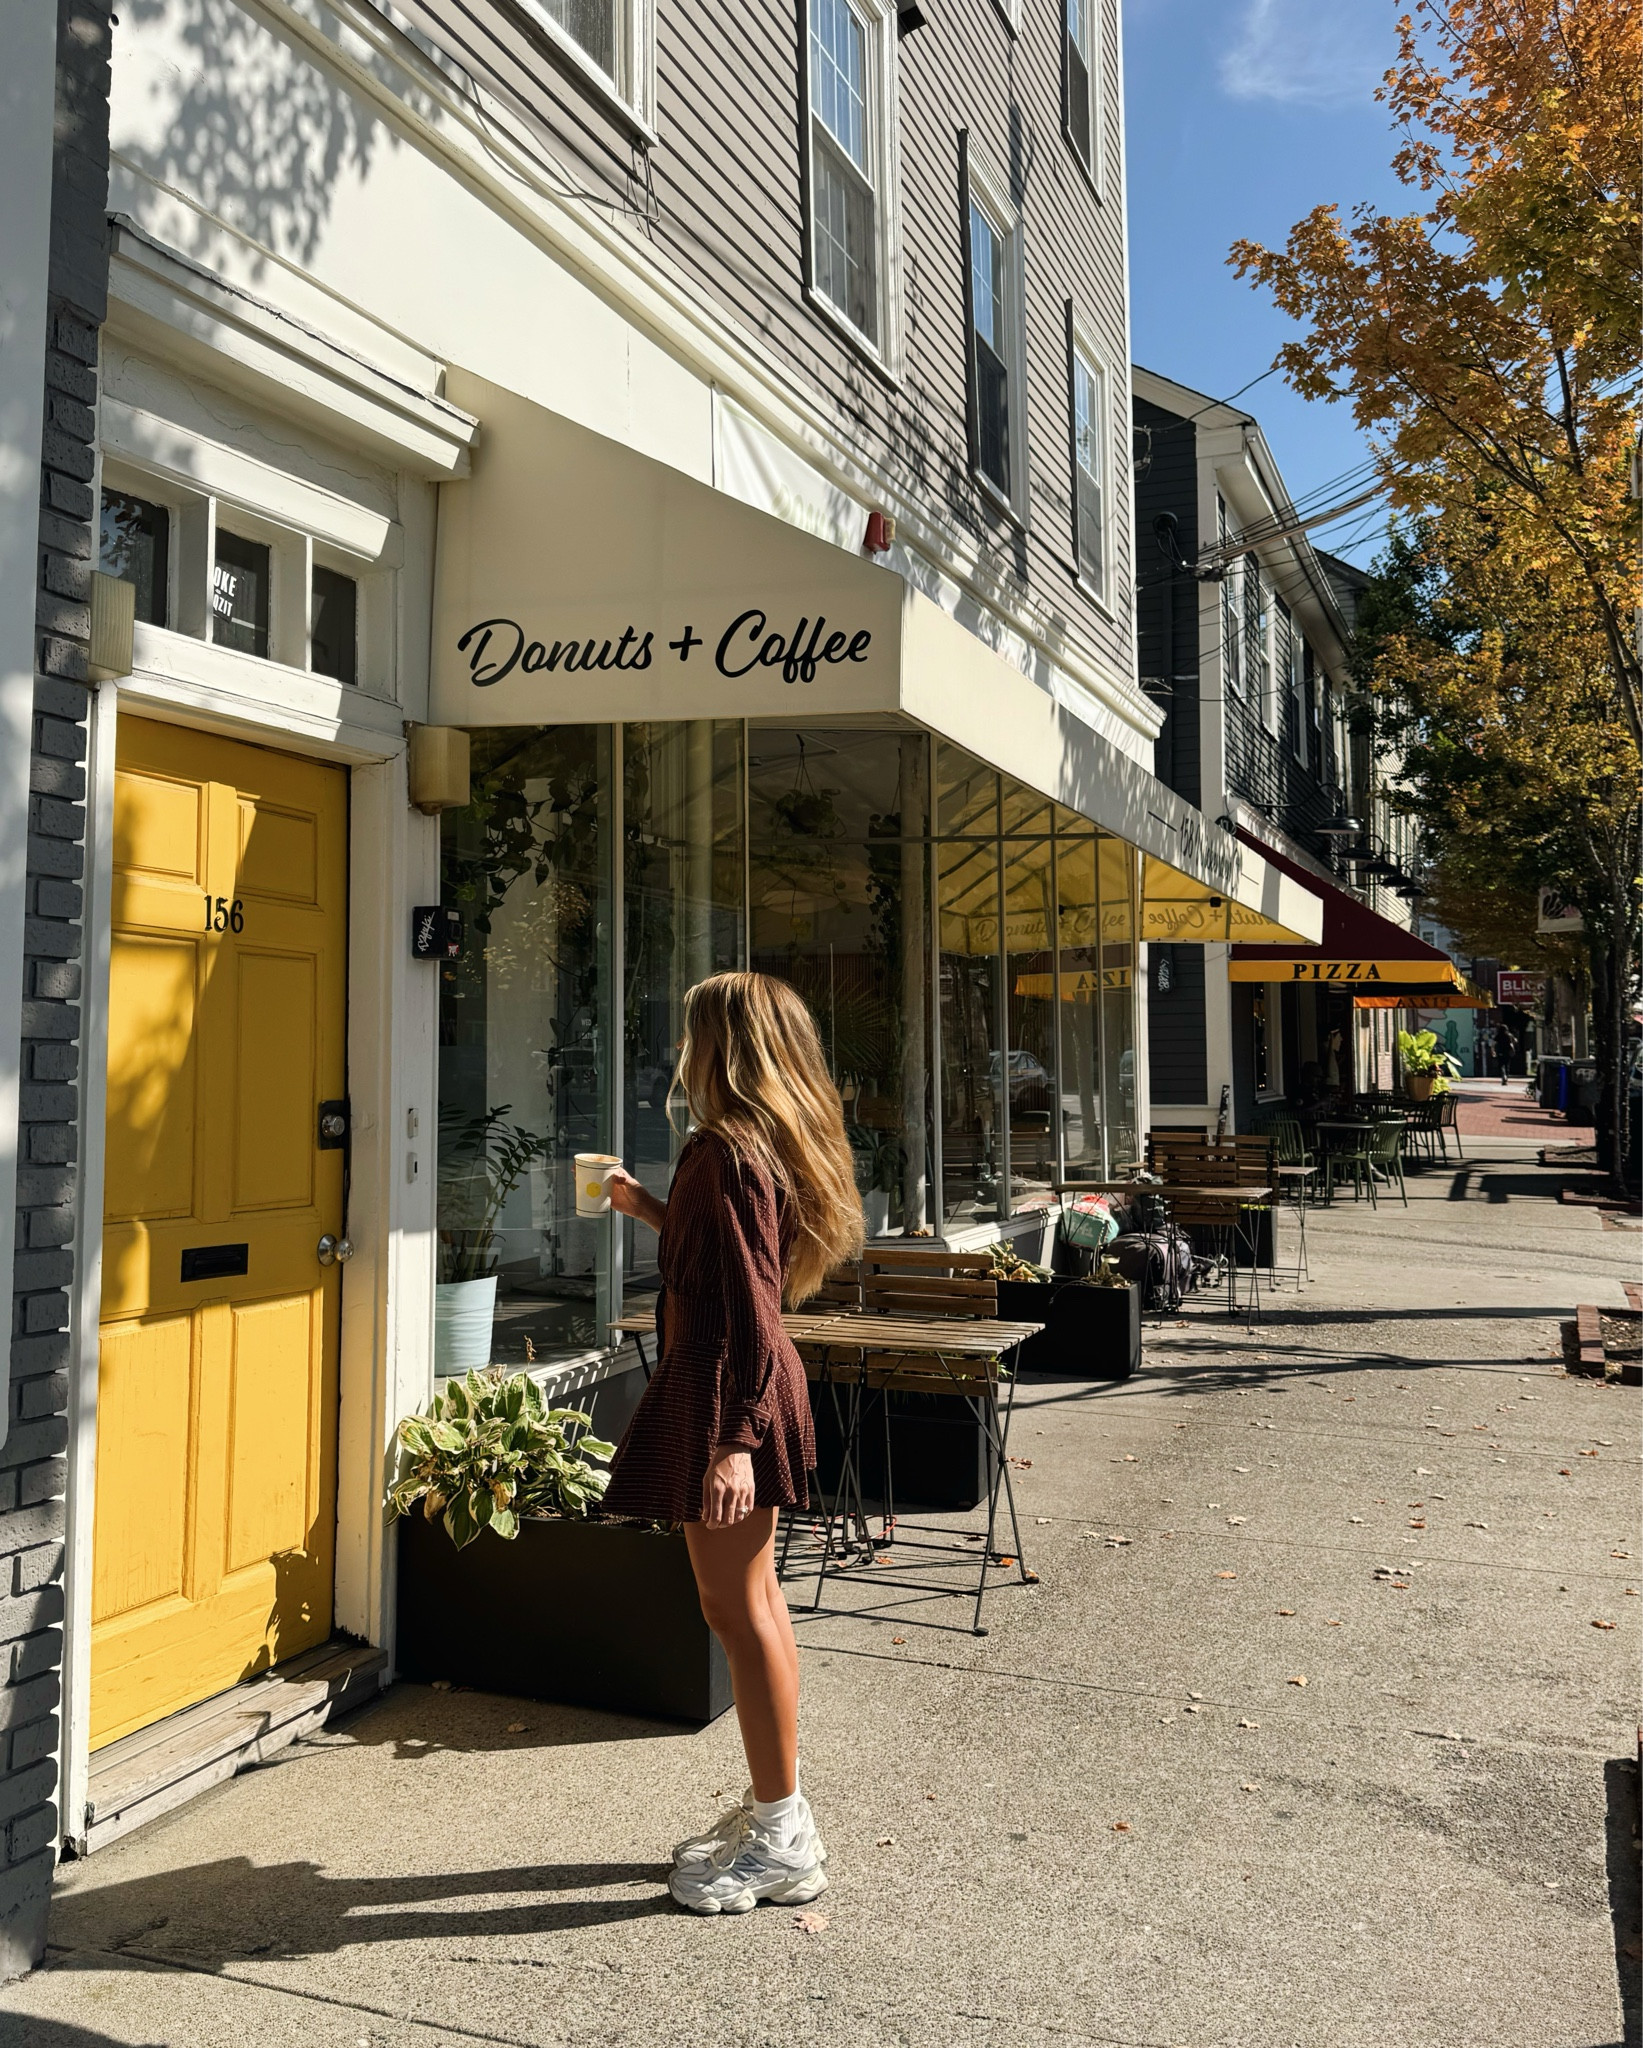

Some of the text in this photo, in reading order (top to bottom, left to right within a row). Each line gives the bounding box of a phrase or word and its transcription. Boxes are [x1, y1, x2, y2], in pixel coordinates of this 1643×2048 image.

[457, 609, 872, 687] Donuts + Coffee
[1181, 813, 1194, 859] 158
[204, 895, 244, 934] 156
[1073, 910, 1126, 934] Cofee
[1292, 963, 1381, 980] PIZZA
